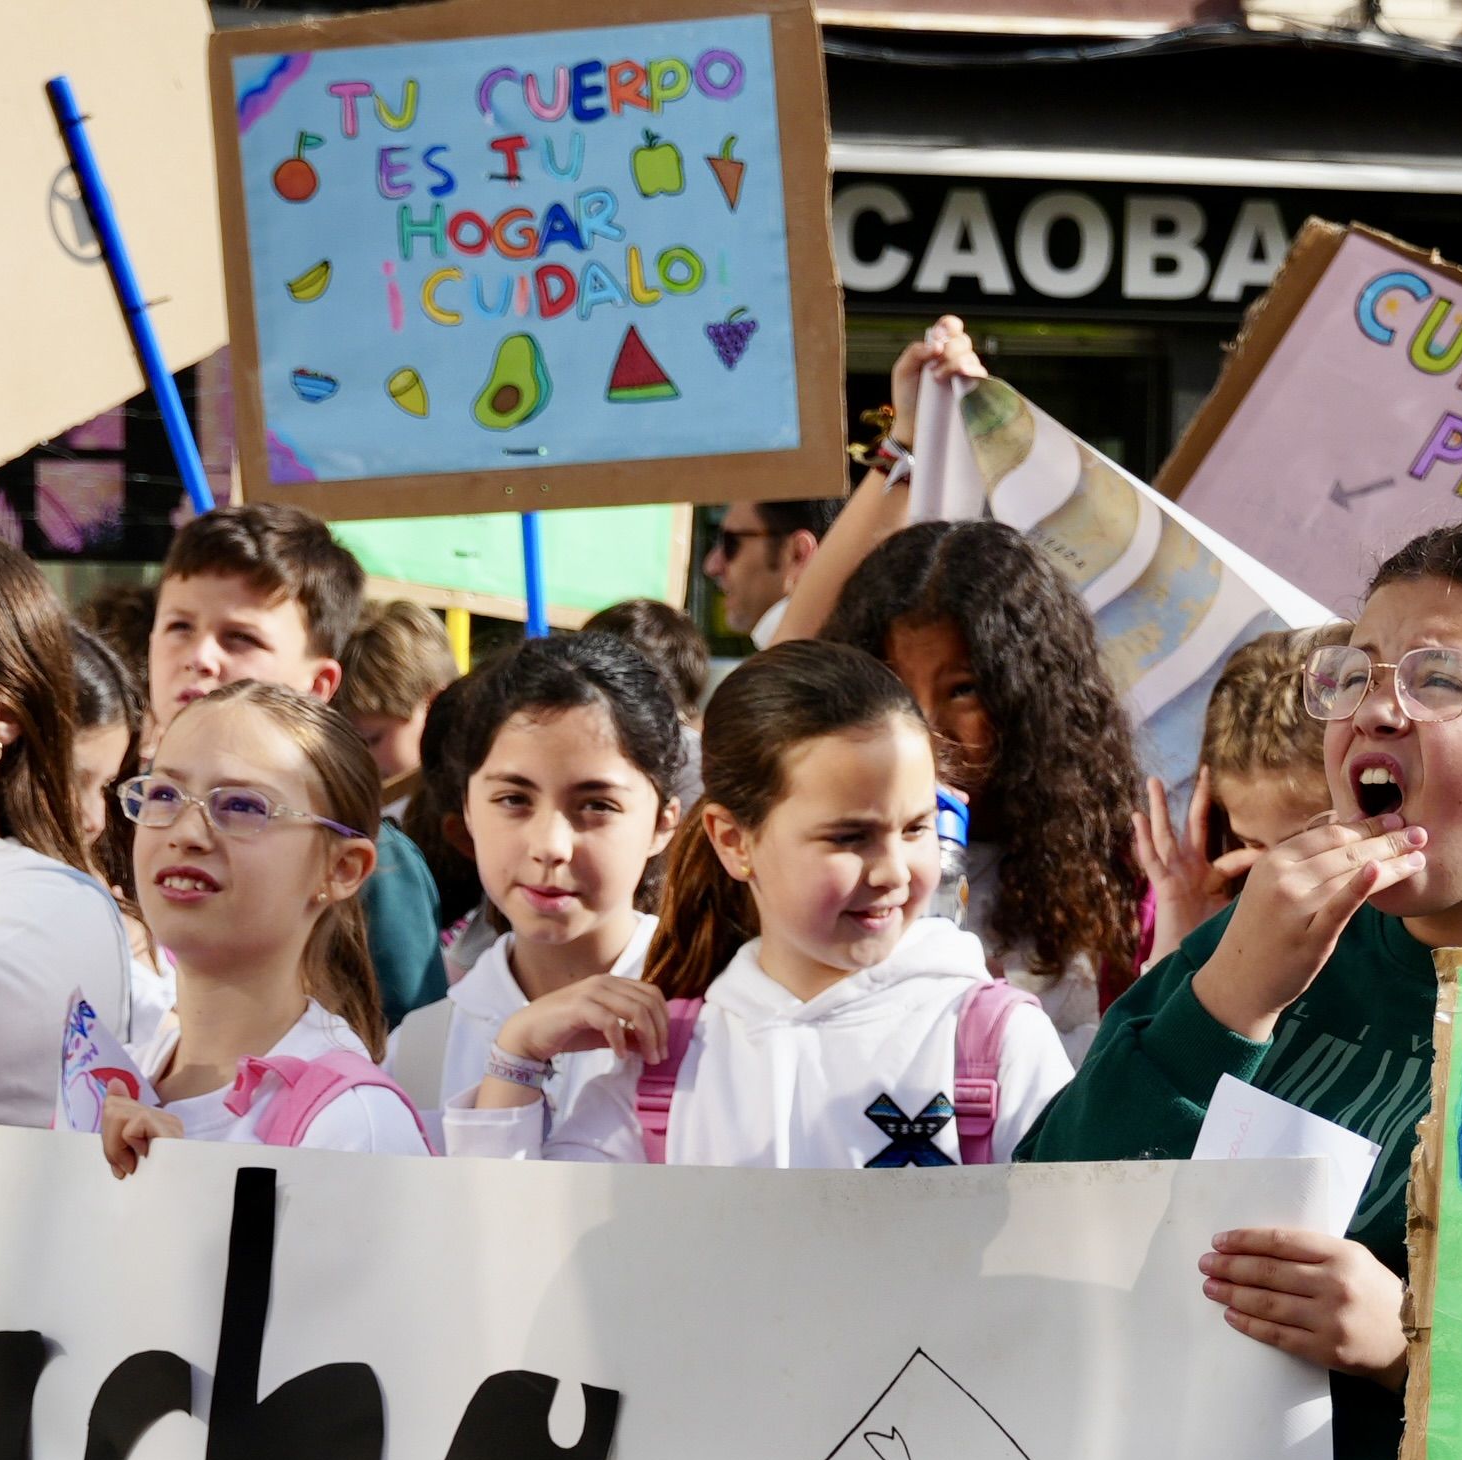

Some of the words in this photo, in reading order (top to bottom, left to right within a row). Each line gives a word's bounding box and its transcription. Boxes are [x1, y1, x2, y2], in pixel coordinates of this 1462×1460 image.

[328, 78, 419, 138] TU
[476, 48, 745, 128] CUERPO
[378, 143, 457, 200] ES
[396, 189, 625, 261] HOGAR
[836, 182, 1294, 302] CAOBA
